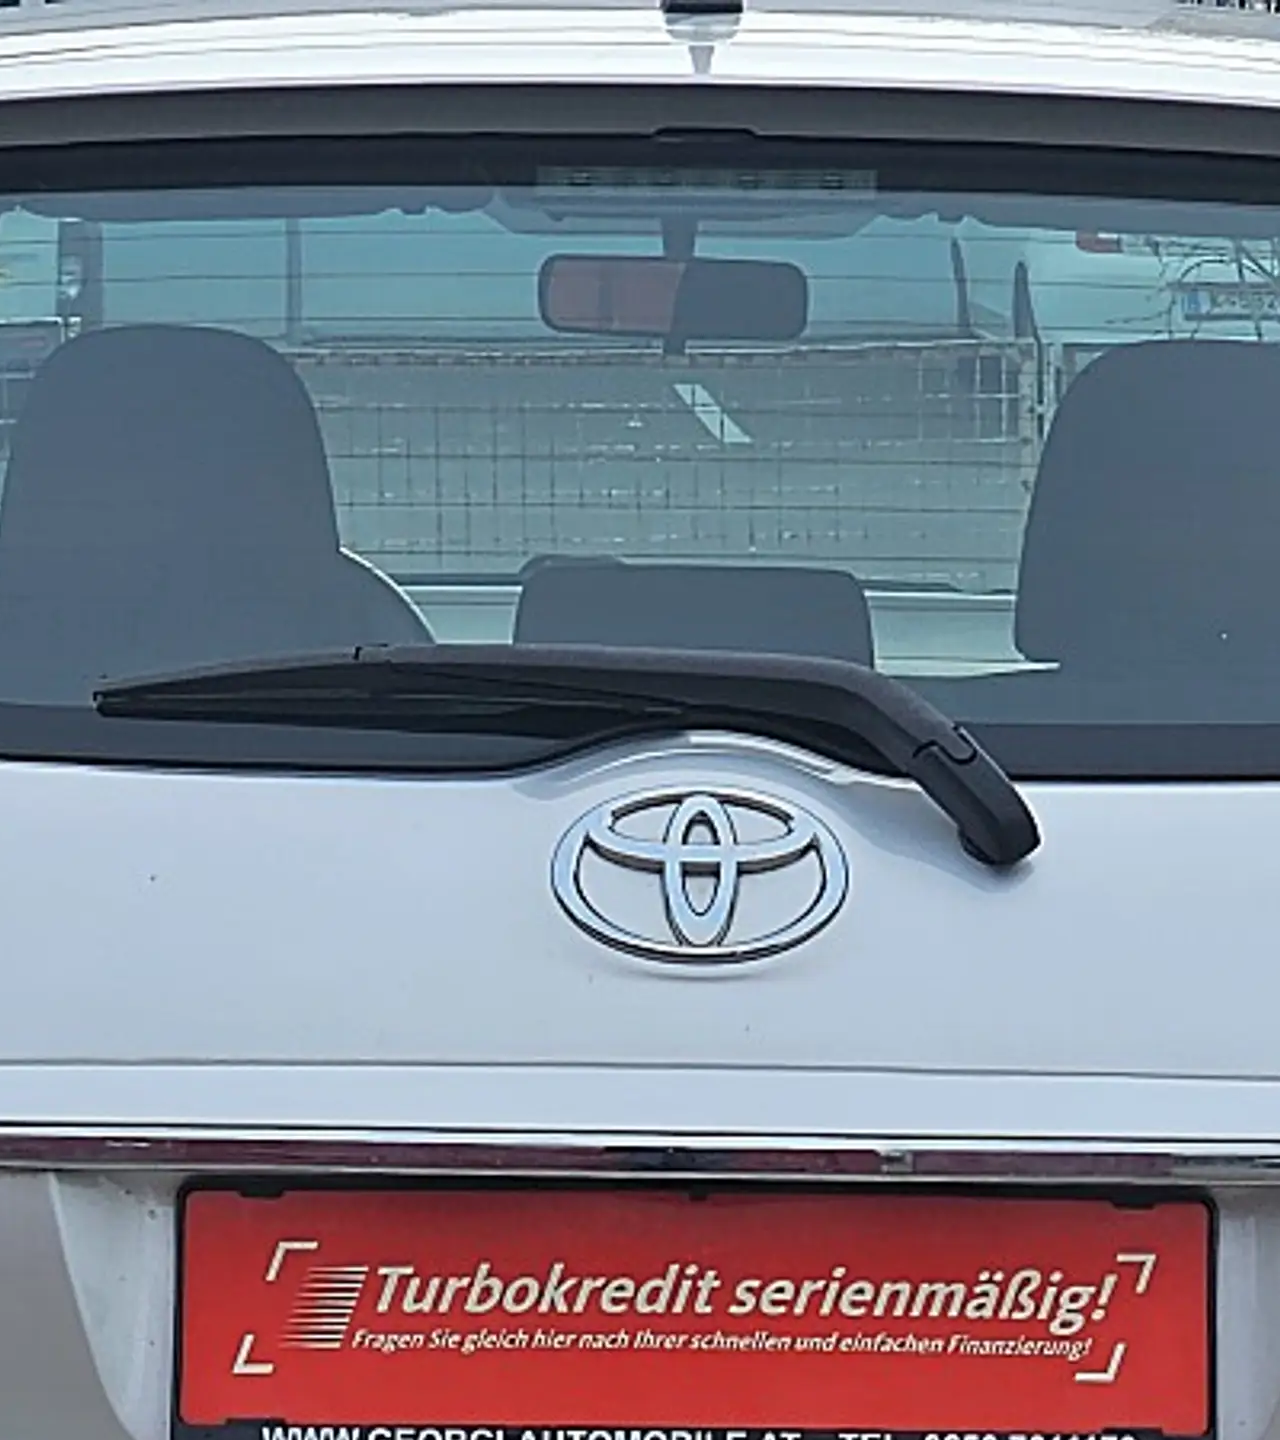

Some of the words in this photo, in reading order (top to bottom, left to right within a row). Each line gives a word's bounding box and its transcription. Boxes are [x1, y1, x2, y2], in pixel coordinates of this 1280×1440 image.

[376, 1262, 721, 1315] Turbokredit
[727, 1265, 1118, 1336] serienmäßig!
[351, 1328, 424, 1353] Fragen
[428, 1327, 462, 1349] Sie
[460, 1328, 529, 1356] gleich
[531, 1329, 577, 1350] hier
[578, 1328, 629, 1350] nach
[633, 1330, 688, 1350] Ihrer
[690, 1330, 792, 1352] schnellen
[793, 1333, 840, 1353] und
[838, 1332, 945, 1354] einfachen
[947, 1334, 1093, 1363] Finanzierung!
